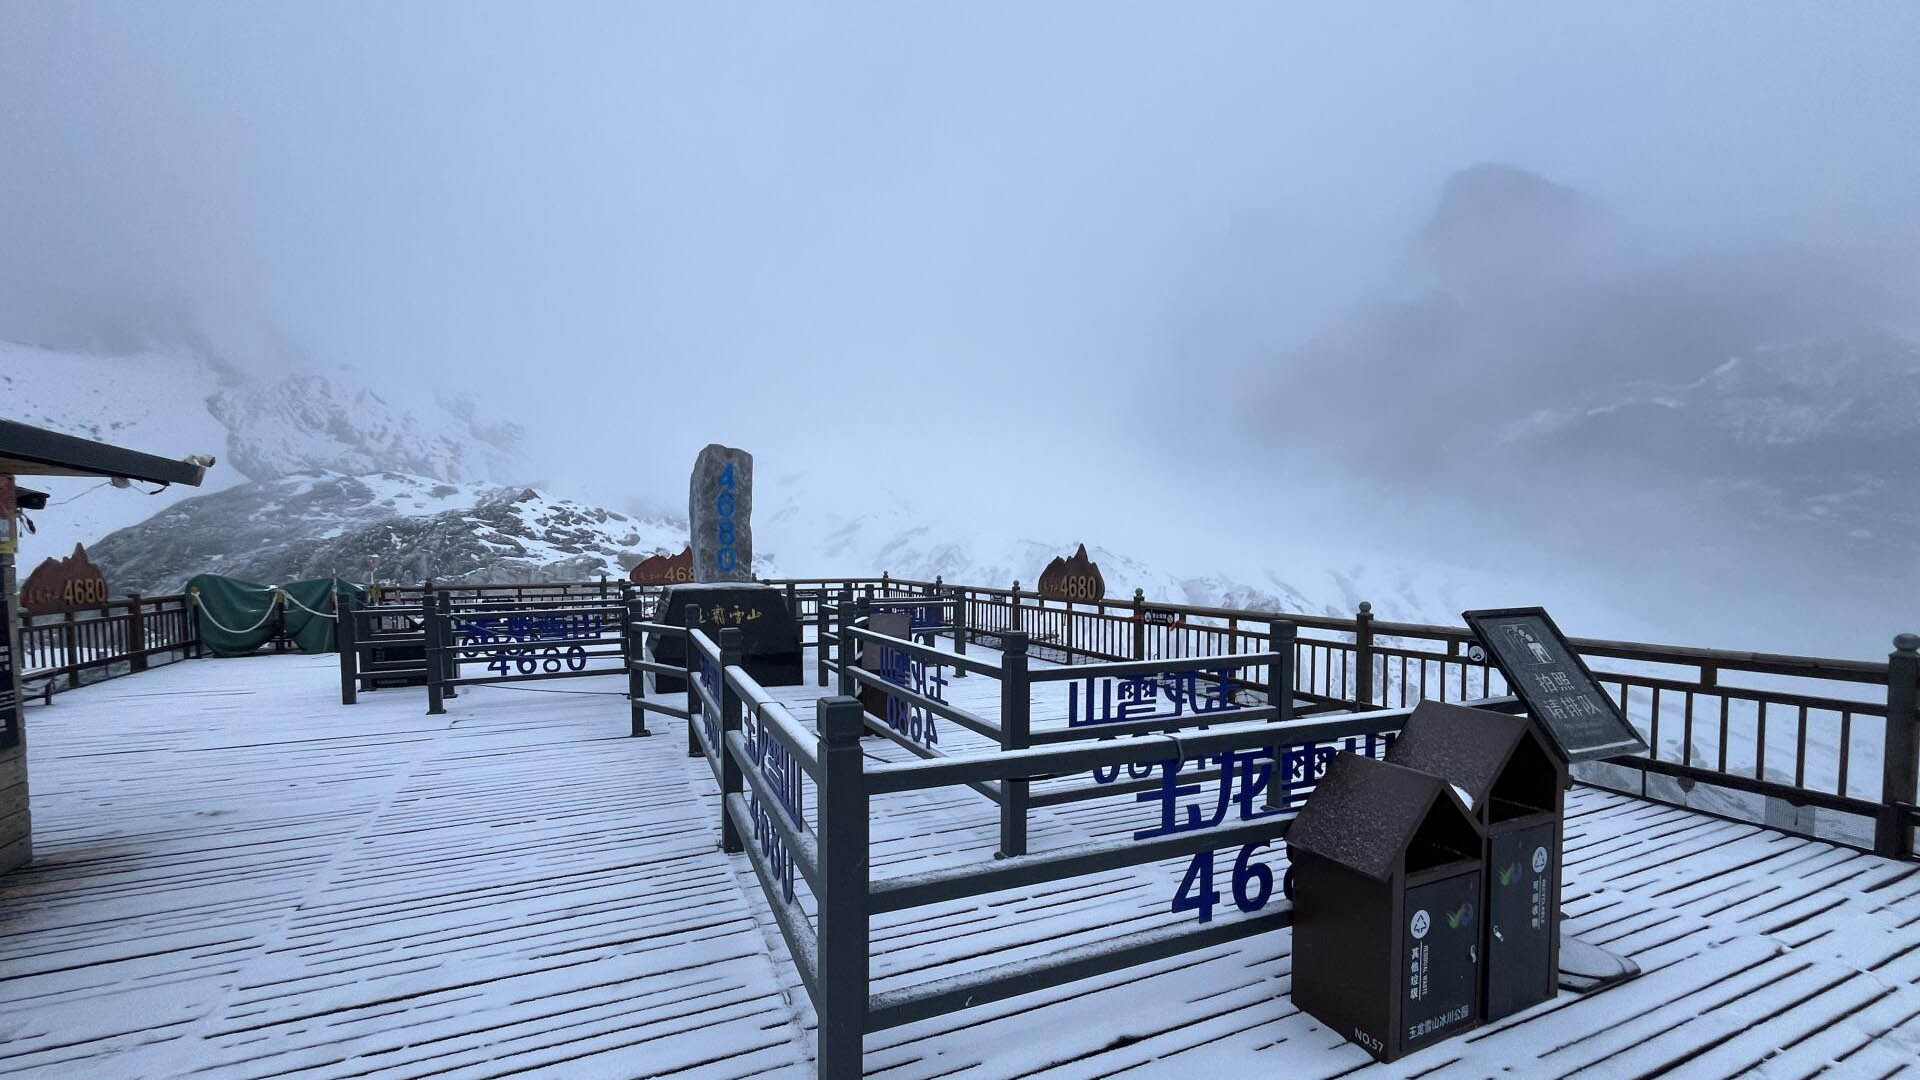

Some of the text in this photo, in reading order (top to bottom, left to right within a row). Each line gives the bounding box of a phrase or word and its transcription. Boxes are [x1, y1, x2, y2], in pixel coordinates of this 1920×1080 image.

[716, 462, 737, 572] 4680
[63, 578, 105, 606] 4680
[1059, 575, 1097, 599] 4680
[487, 645, 587, 676] 4680
[1535, 671, 1575, 693] 拍照
[1545, 694, 1602, 720] 请排队
[1171, 841, 1294, 924] 46
[1354, 1027, 1384, 1053] NO.57
